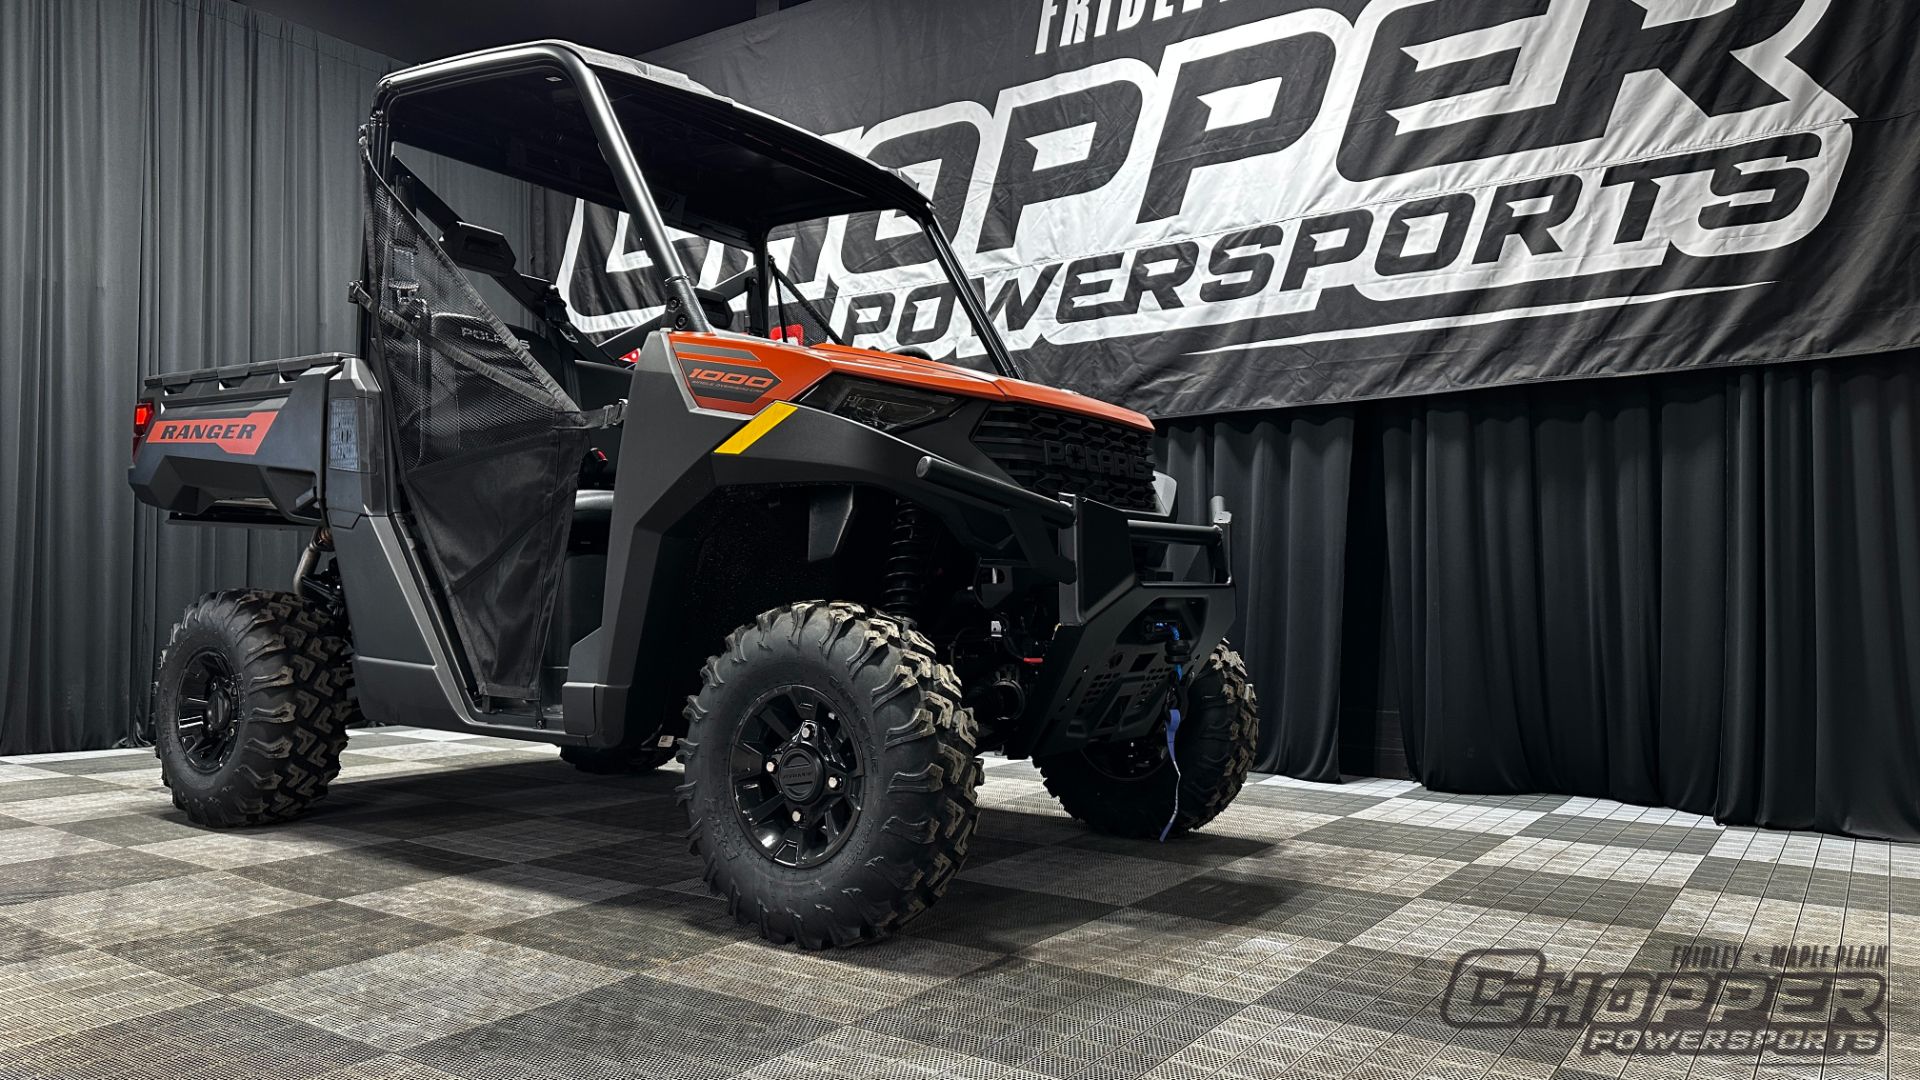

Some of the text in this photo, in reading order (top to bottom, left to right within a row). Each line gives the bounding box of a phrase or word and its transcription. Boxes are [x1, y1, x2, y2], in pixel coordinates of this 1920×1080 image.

[842, 132, 1823, 345] POWERSPORTS
[688, 368, 774, 388] 1000
[160, 424, 257, 440] RANGER
[1043, 439, 1152, 480] POLARIS
